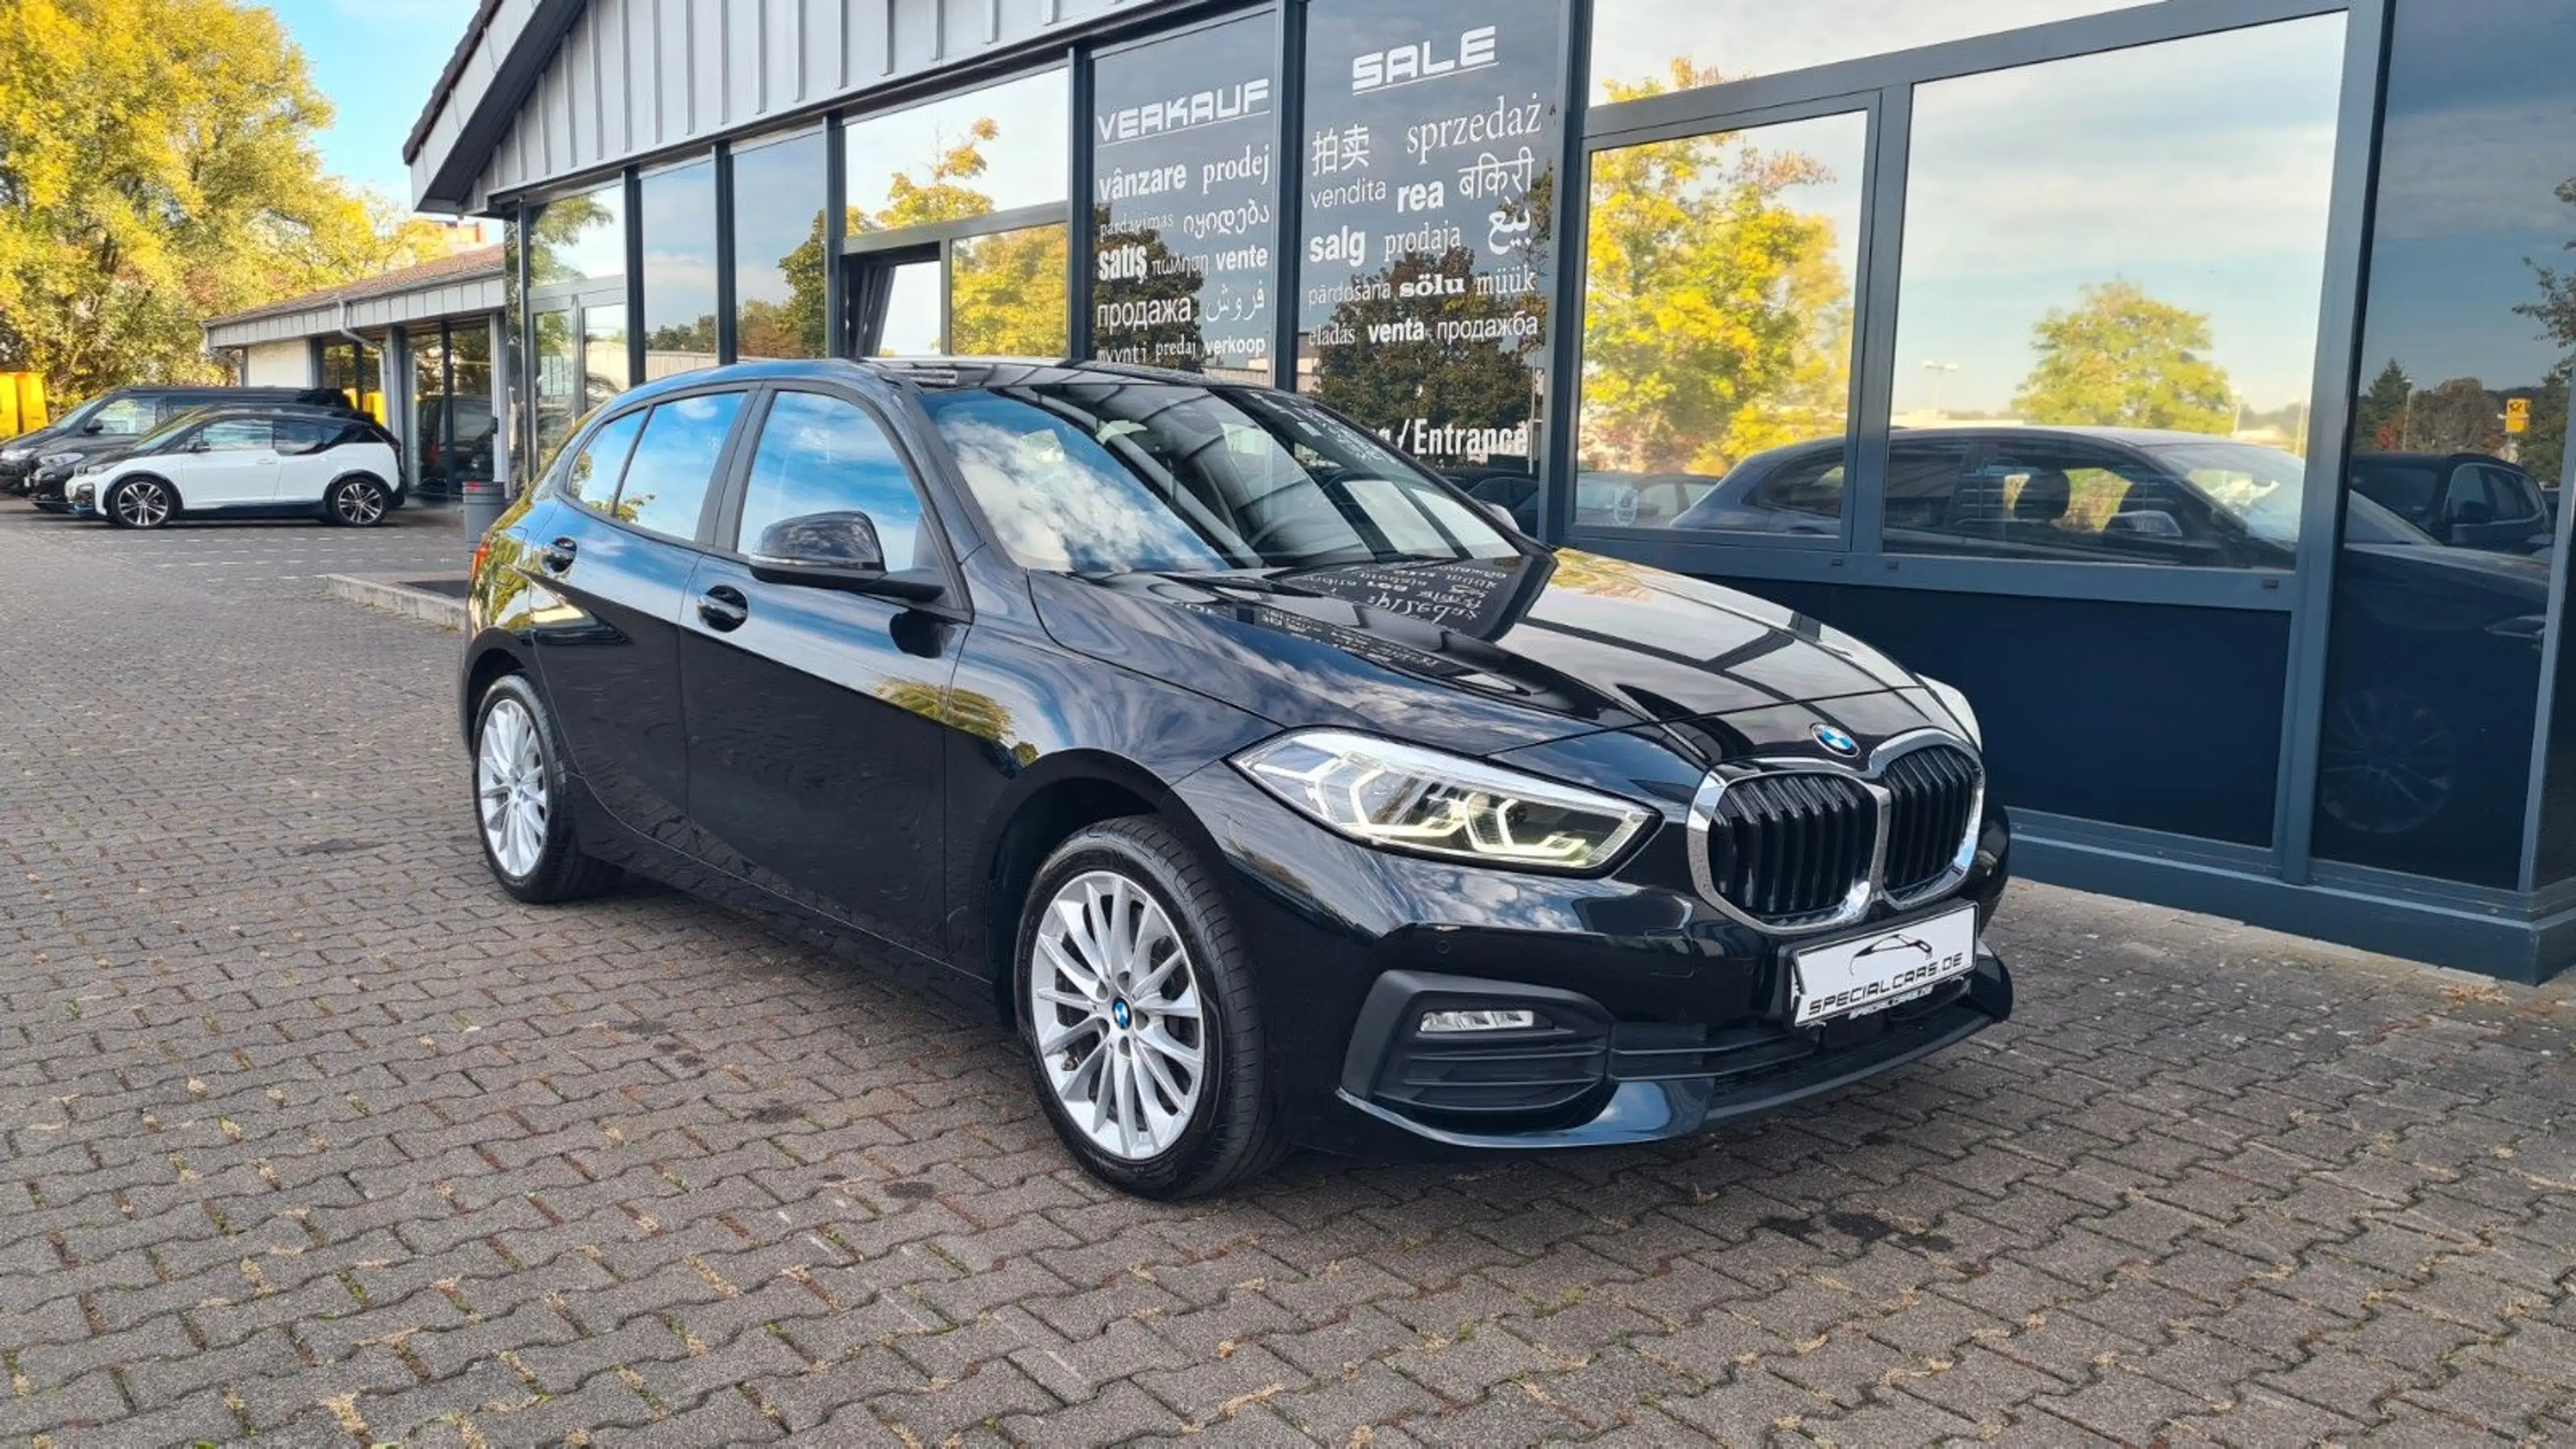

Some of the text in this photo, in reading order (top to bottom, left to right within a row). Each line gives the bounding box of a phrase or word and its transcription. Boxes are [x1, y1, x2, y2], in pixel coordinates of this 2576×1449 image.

[1352, 25, 1495, 91] SALE
[1097, 78, 1269, 142] VERKAUF
[1407, 92, 1542, 165] sprzedaż
[1311, 123, 1371, 176] 拍卖
[1099, 144, 1269, 201] vânzare prodej
[1310, 177, 1444, 213] vendita rea
[1183, 198, 1270, 239] იყიდება
[1216, 244, 1268, 271] vente
[1309, 220, 1461, 267] salg prodaja
[1308, 264, 1536, 311] pārdošana sölu müük
[1097, 297, 1191, 335] продажа
[1308, 317, 1425, 345] eladás venta
[1437, 310, 1538, 344] продажба
[1155, 333, 1196, 362] predaj
[1204, 335, 1265, 356] verkoop
